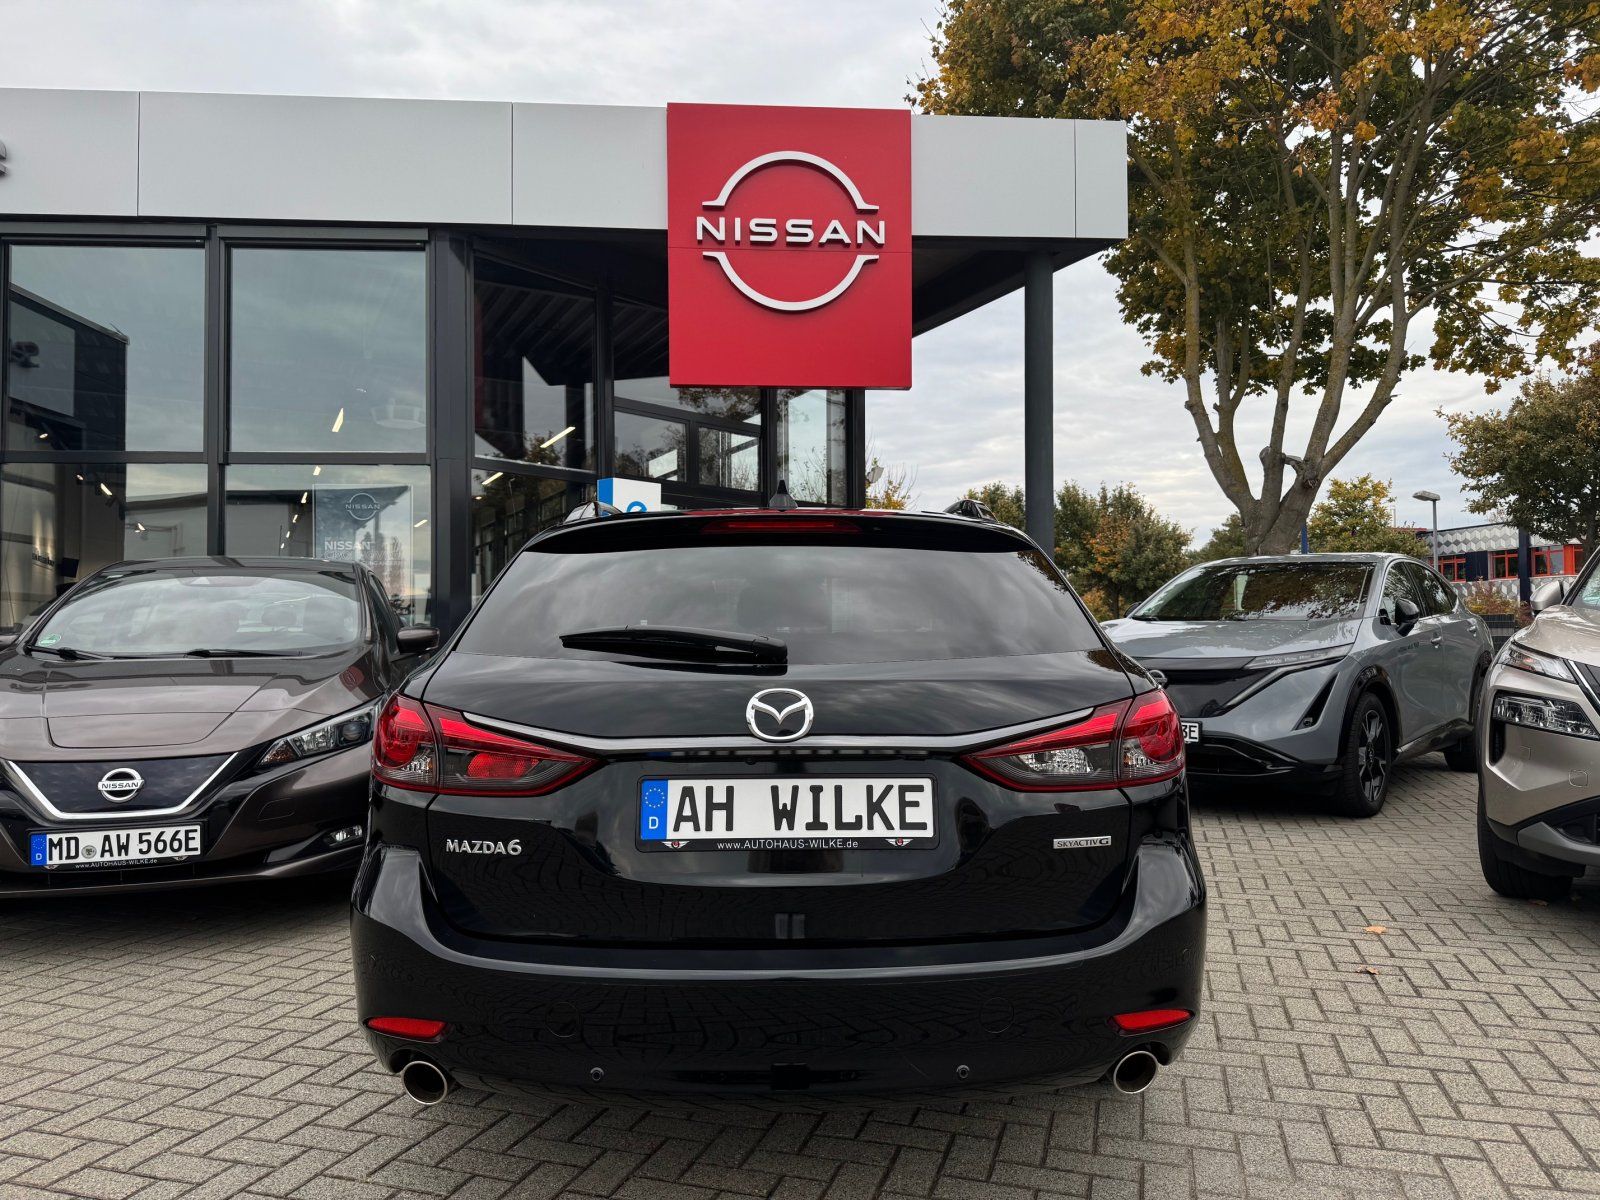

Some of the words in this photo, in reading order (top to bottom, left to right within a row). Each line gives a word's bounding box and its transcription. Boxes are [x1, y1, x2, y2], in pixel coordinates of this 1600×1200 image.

[696, 216, 886, 246] NISSAN
[324, 541, 371, 550] NISSAN
[101, 781, 139, 790] NISSAN
[648, 816, 659, 829] D
[672, 785, 735, 832] AH
[770, 784, 928, 831] WILKE
[48, 836, 80, 861] MD
[100, 832, 131, 858] AW
[137, 829, 199, 855] 566E
[717, 839, 859, 849] www.AUTOHAUS-WILKE.de
[75, 858, 158, 869] www.AUTOHAUS-WILKE.de
